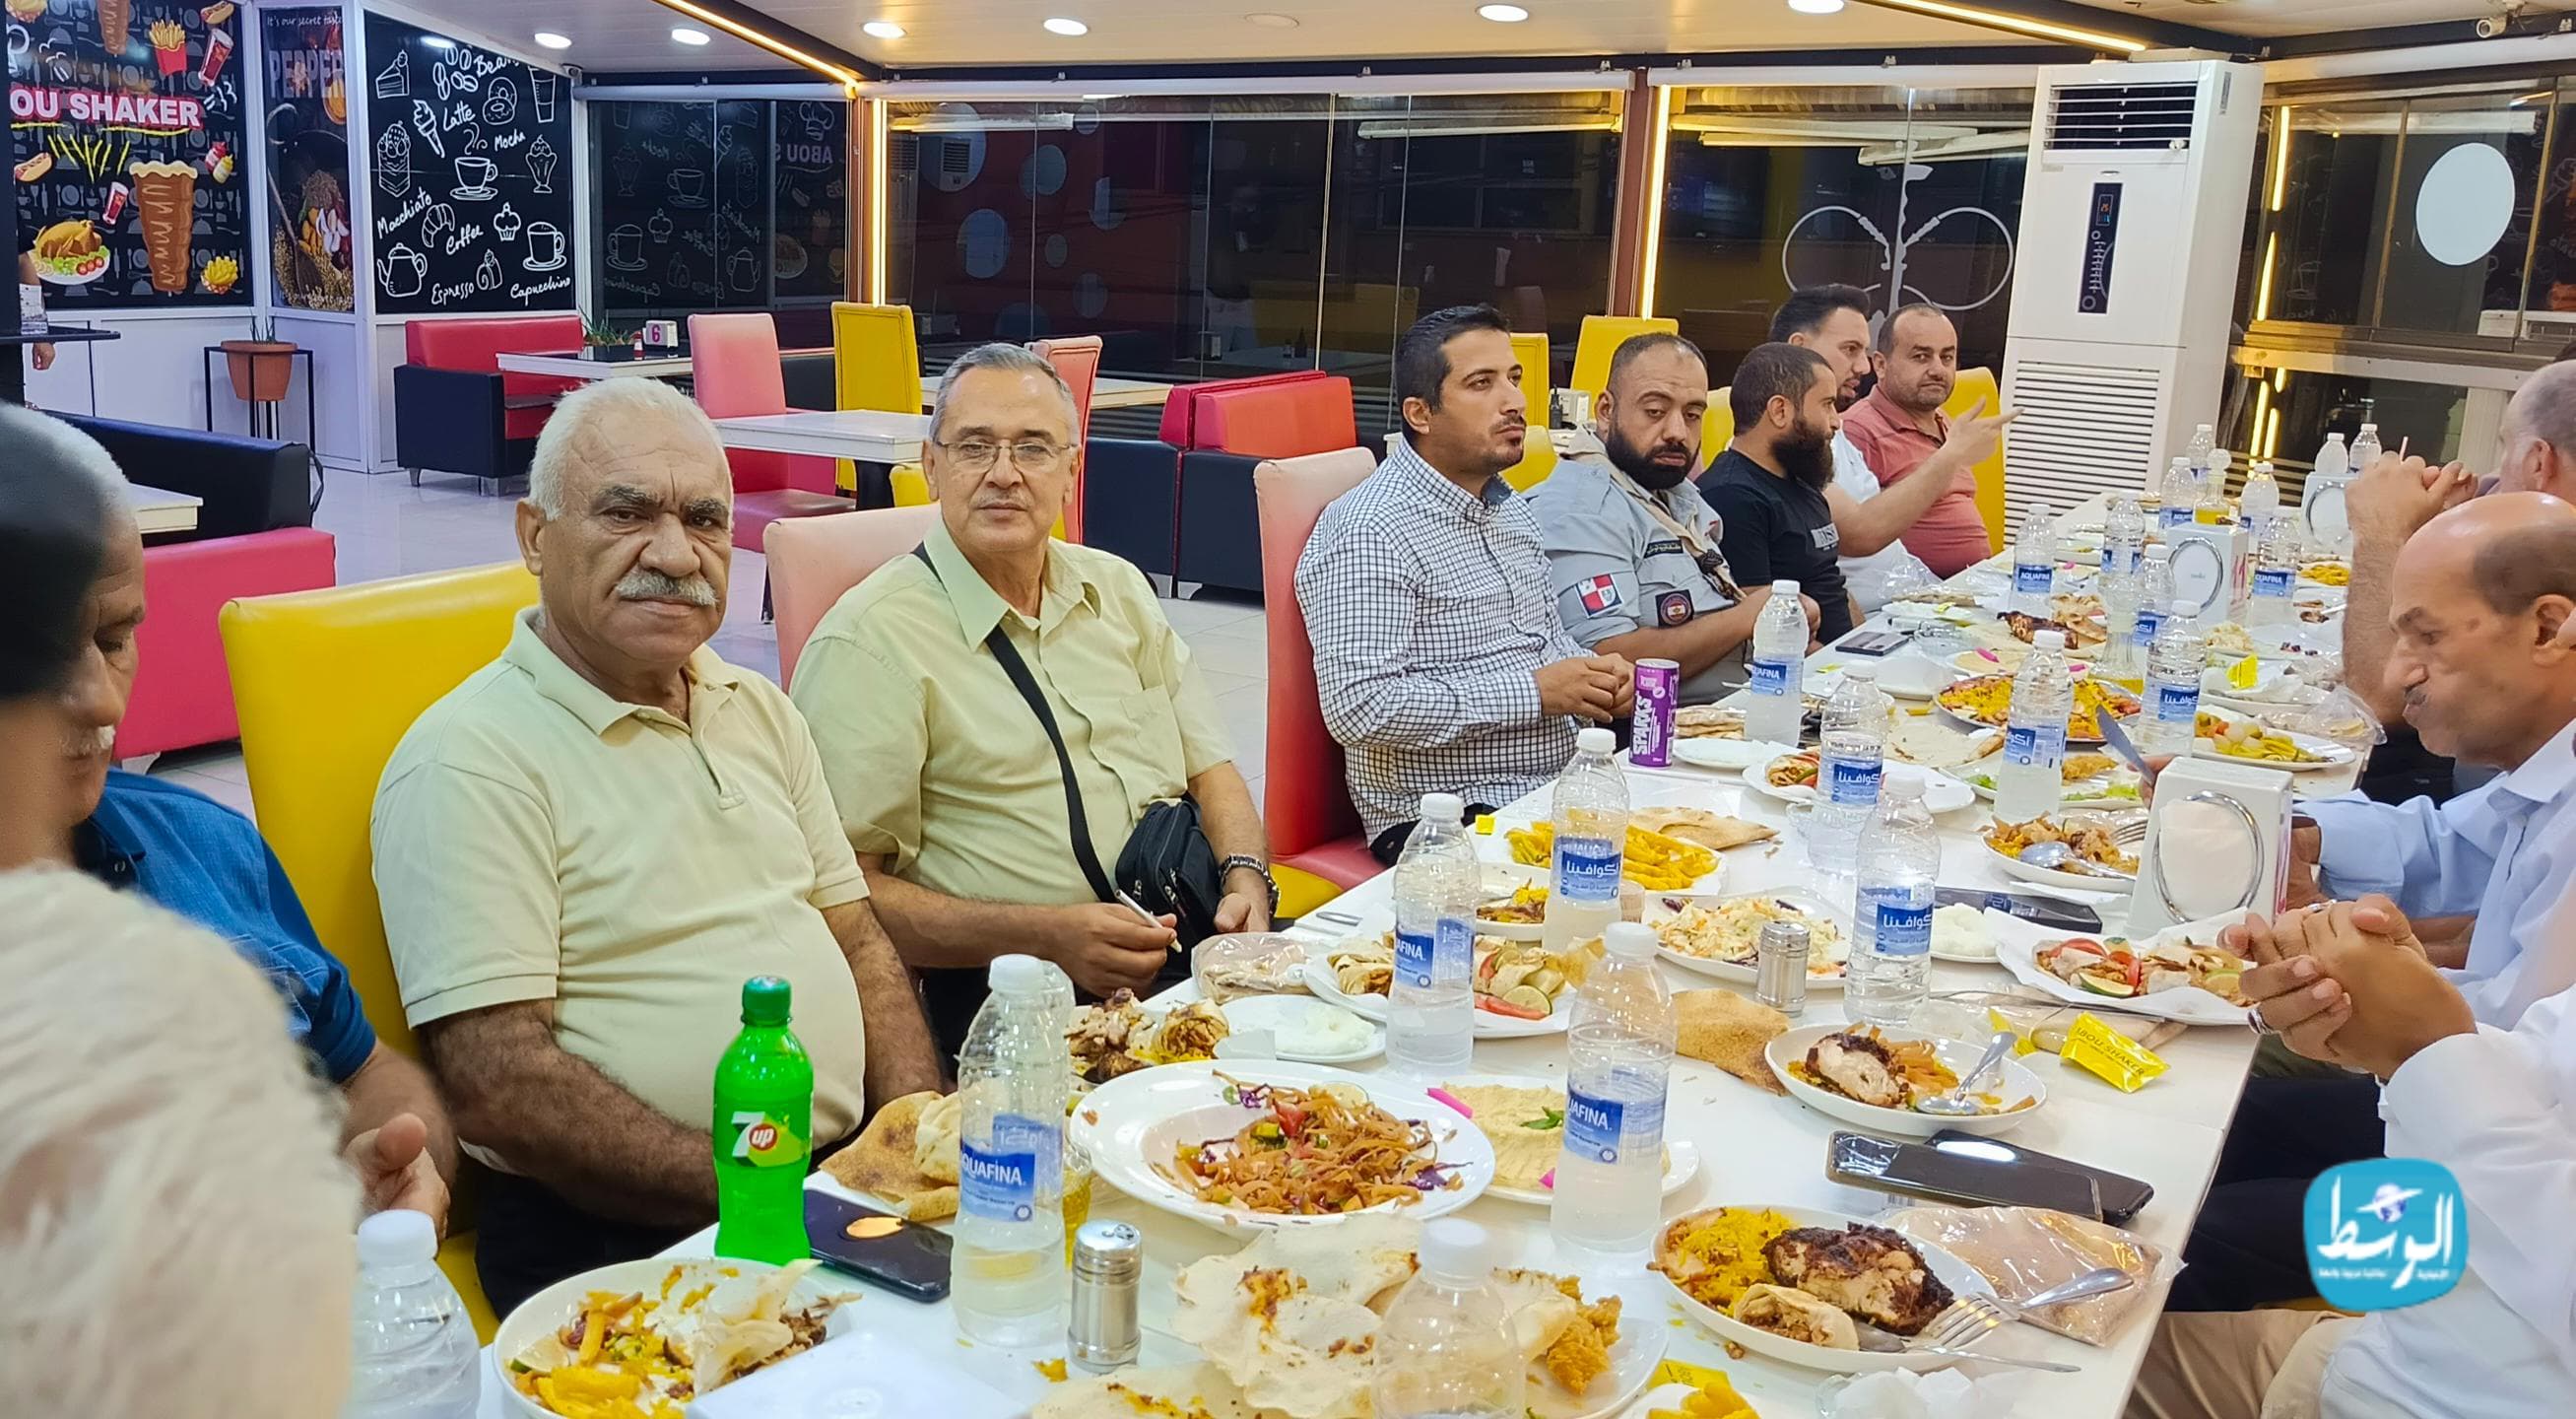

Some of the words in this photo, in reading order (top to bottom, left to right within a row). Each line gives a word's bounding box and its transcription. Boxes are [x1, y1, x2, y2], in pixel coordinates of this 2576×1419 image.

[474, 54, 520, 78] Bea
[10, 90, 58, 118] OU
[69, 92, 202, 127] SHAKER
[443, 101, 477, 132] Latte
[495, 128, 527, 152] Mocha
[376, 185, 433, 239] Macchiato
[446, 223, 484, 255] Coffee
[430, 282, 475, 305] Espresso
[651, 324, 661, 343] 6
[1633, 696, 1653, 755] SPARKS
[1838, 771, 1879, 786] كوافينا
[1883, 913, 1932, 930] كوافينا
[2107, 1045, 2146, 1076] SHAKER
[961, 1152, 1023, 1186] QUAFINA
